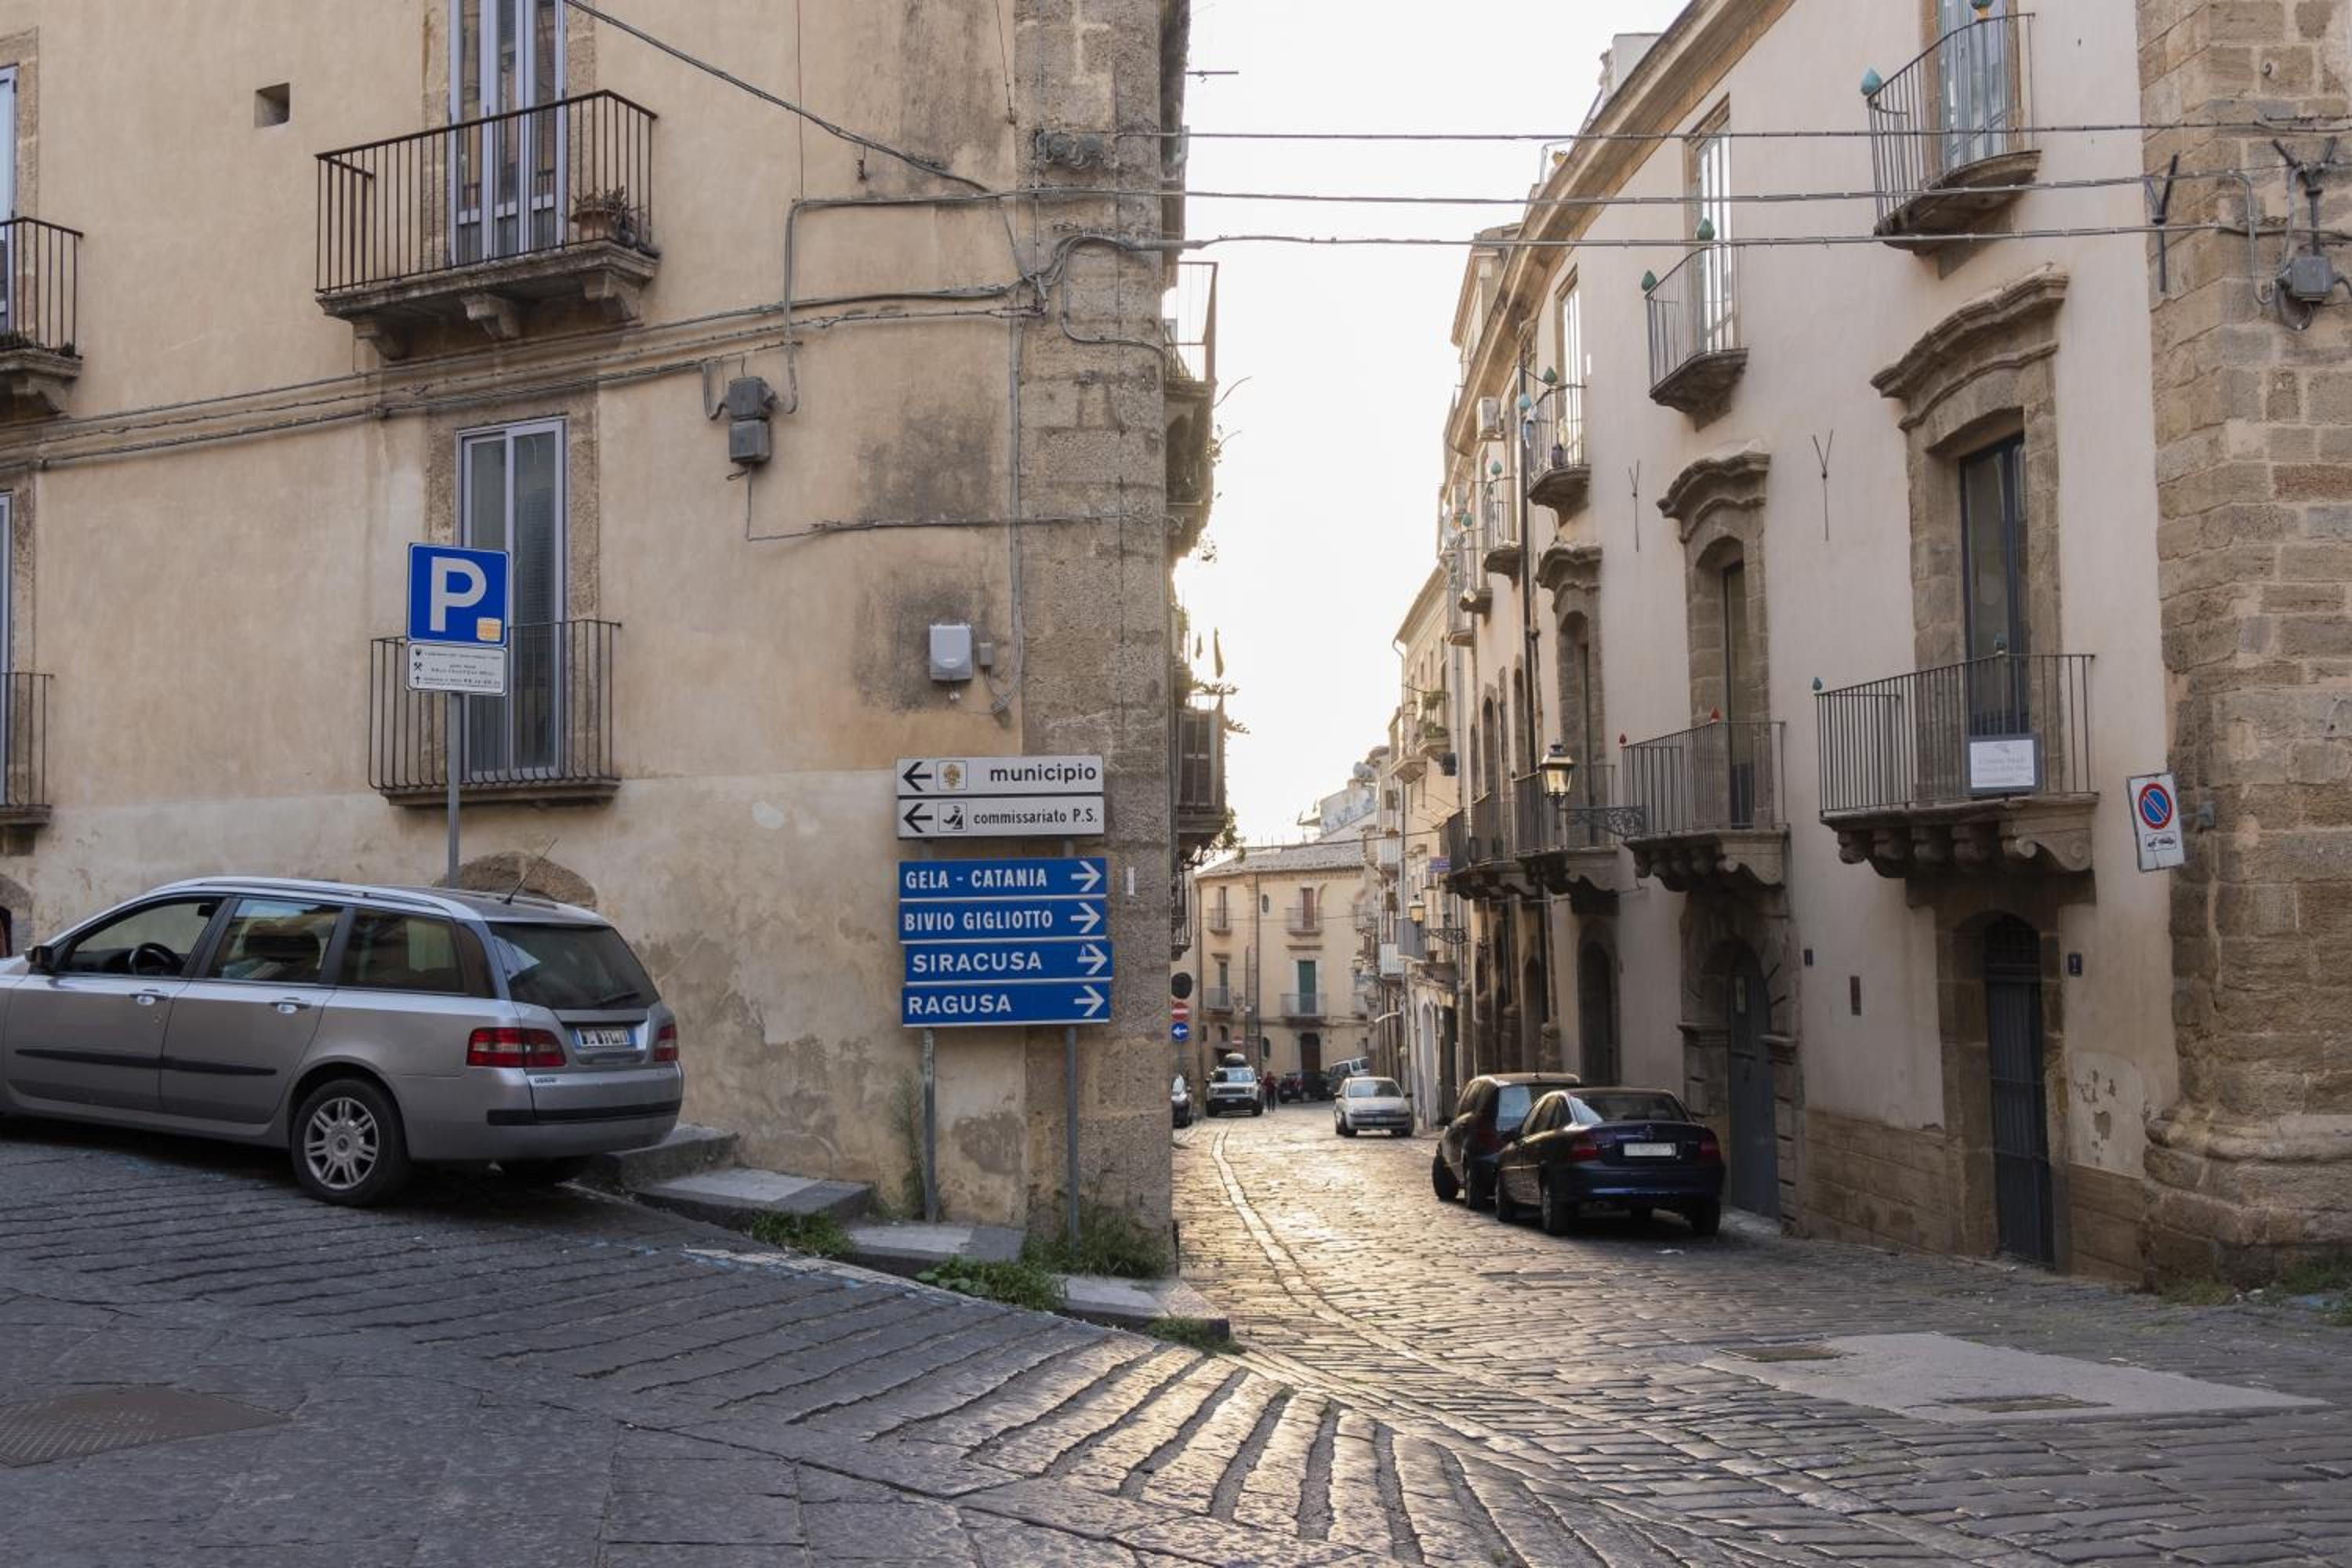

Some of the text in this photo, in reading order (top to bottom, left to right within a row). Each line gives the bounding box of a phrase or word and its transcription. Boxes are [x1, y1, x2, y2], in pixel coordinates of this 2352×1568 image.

[430, 556, 487, 633] P
[990, 763, 1097, 784] municipio
[974, 808, 1098, 825] commissariato P.S.
[906, 870, 949, 889] GELA
[971, 869, 1047, 887] CATANIA
[904, 910, 1054, 931] BIVIO GIGLIOTTO
[913, 952, 1043, 973] SIRACUSA
[908, 994, 1012, 1015] RAGUSA
